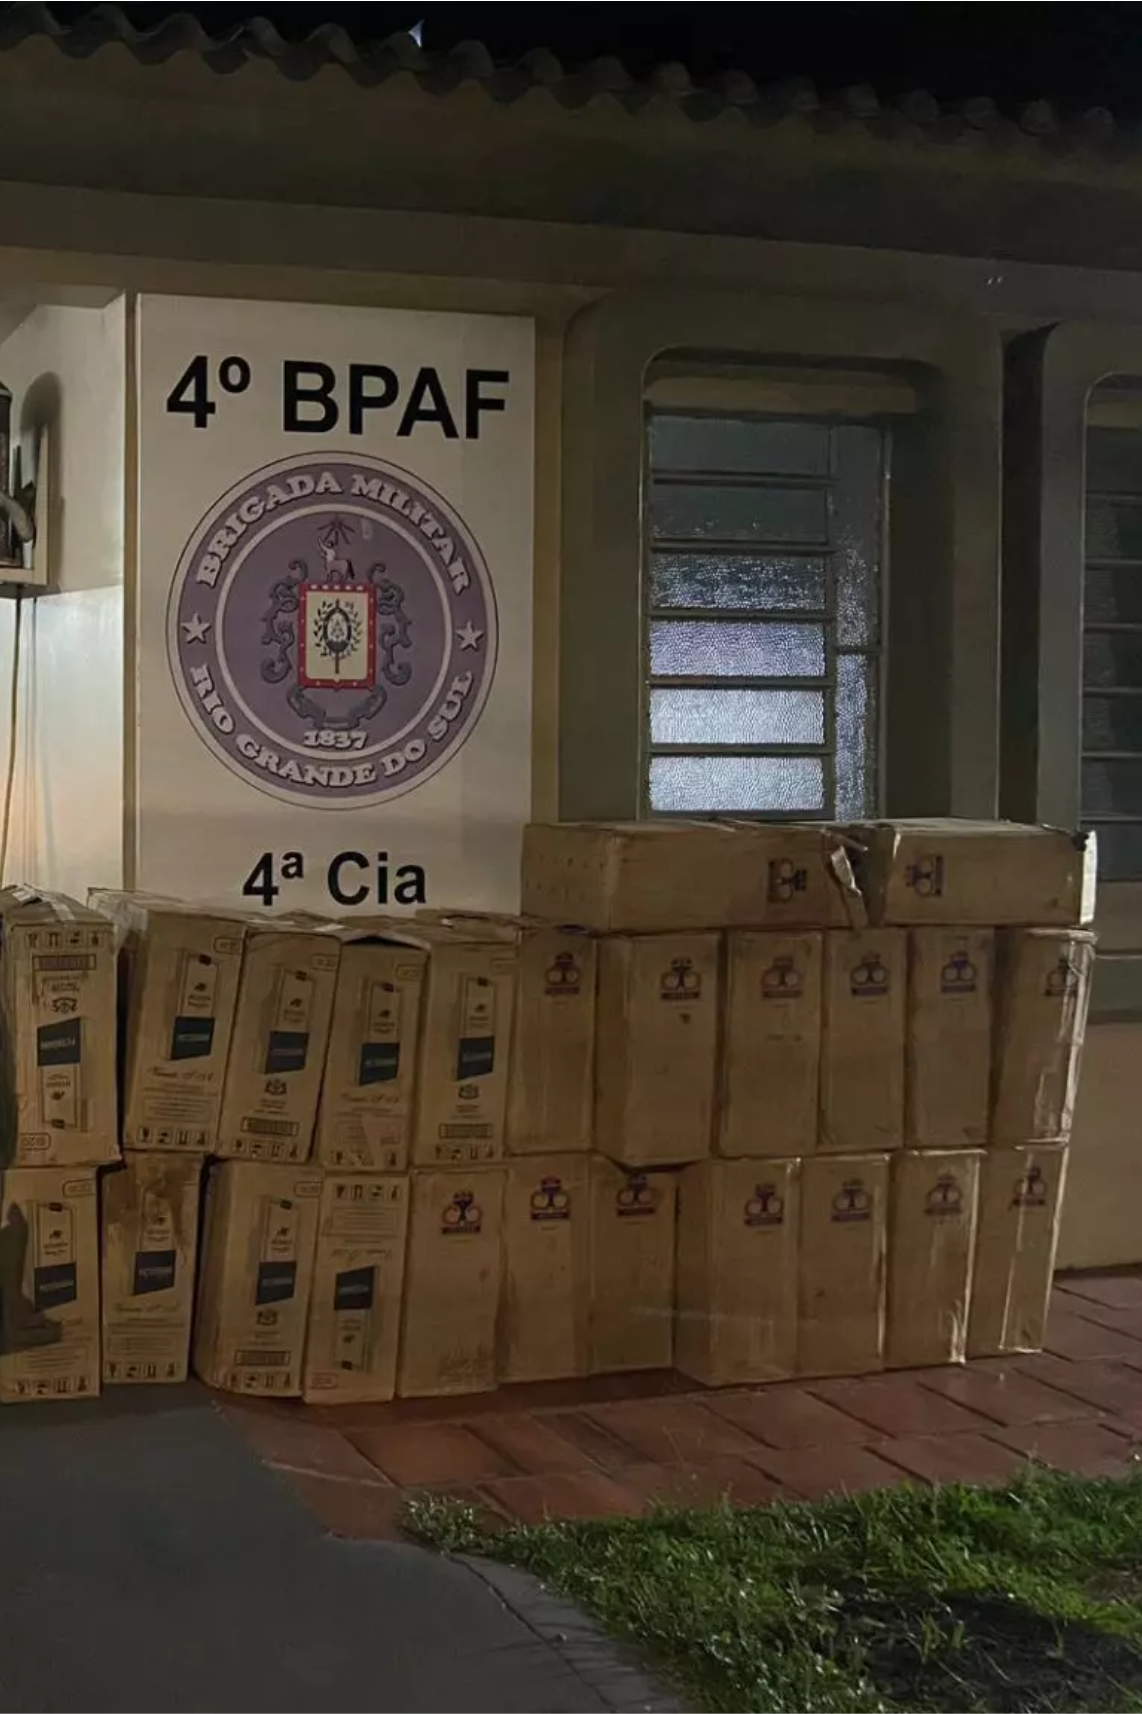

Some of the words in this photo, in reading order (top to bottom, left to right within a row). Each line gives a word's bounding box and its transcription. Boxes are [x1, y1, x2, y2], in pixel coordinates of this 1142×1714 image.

[166, 355, 252, 428] 4º
[283, 359, 509, 440] BPAF
[196, 470, 343, 590] BRIGADA
[351, 473, 472, 595] MILITAR
[189, 663, 235, 734] RIO
[235, 733, 378, 788] GRANDE
[382, 738, 427, 778] DO
[428, 670, 474, 741] SUL
[303, 728, 369, 750] 1837
[242, 850, 304, 906] 4ª
[327, 851, 427, 906] Cia
